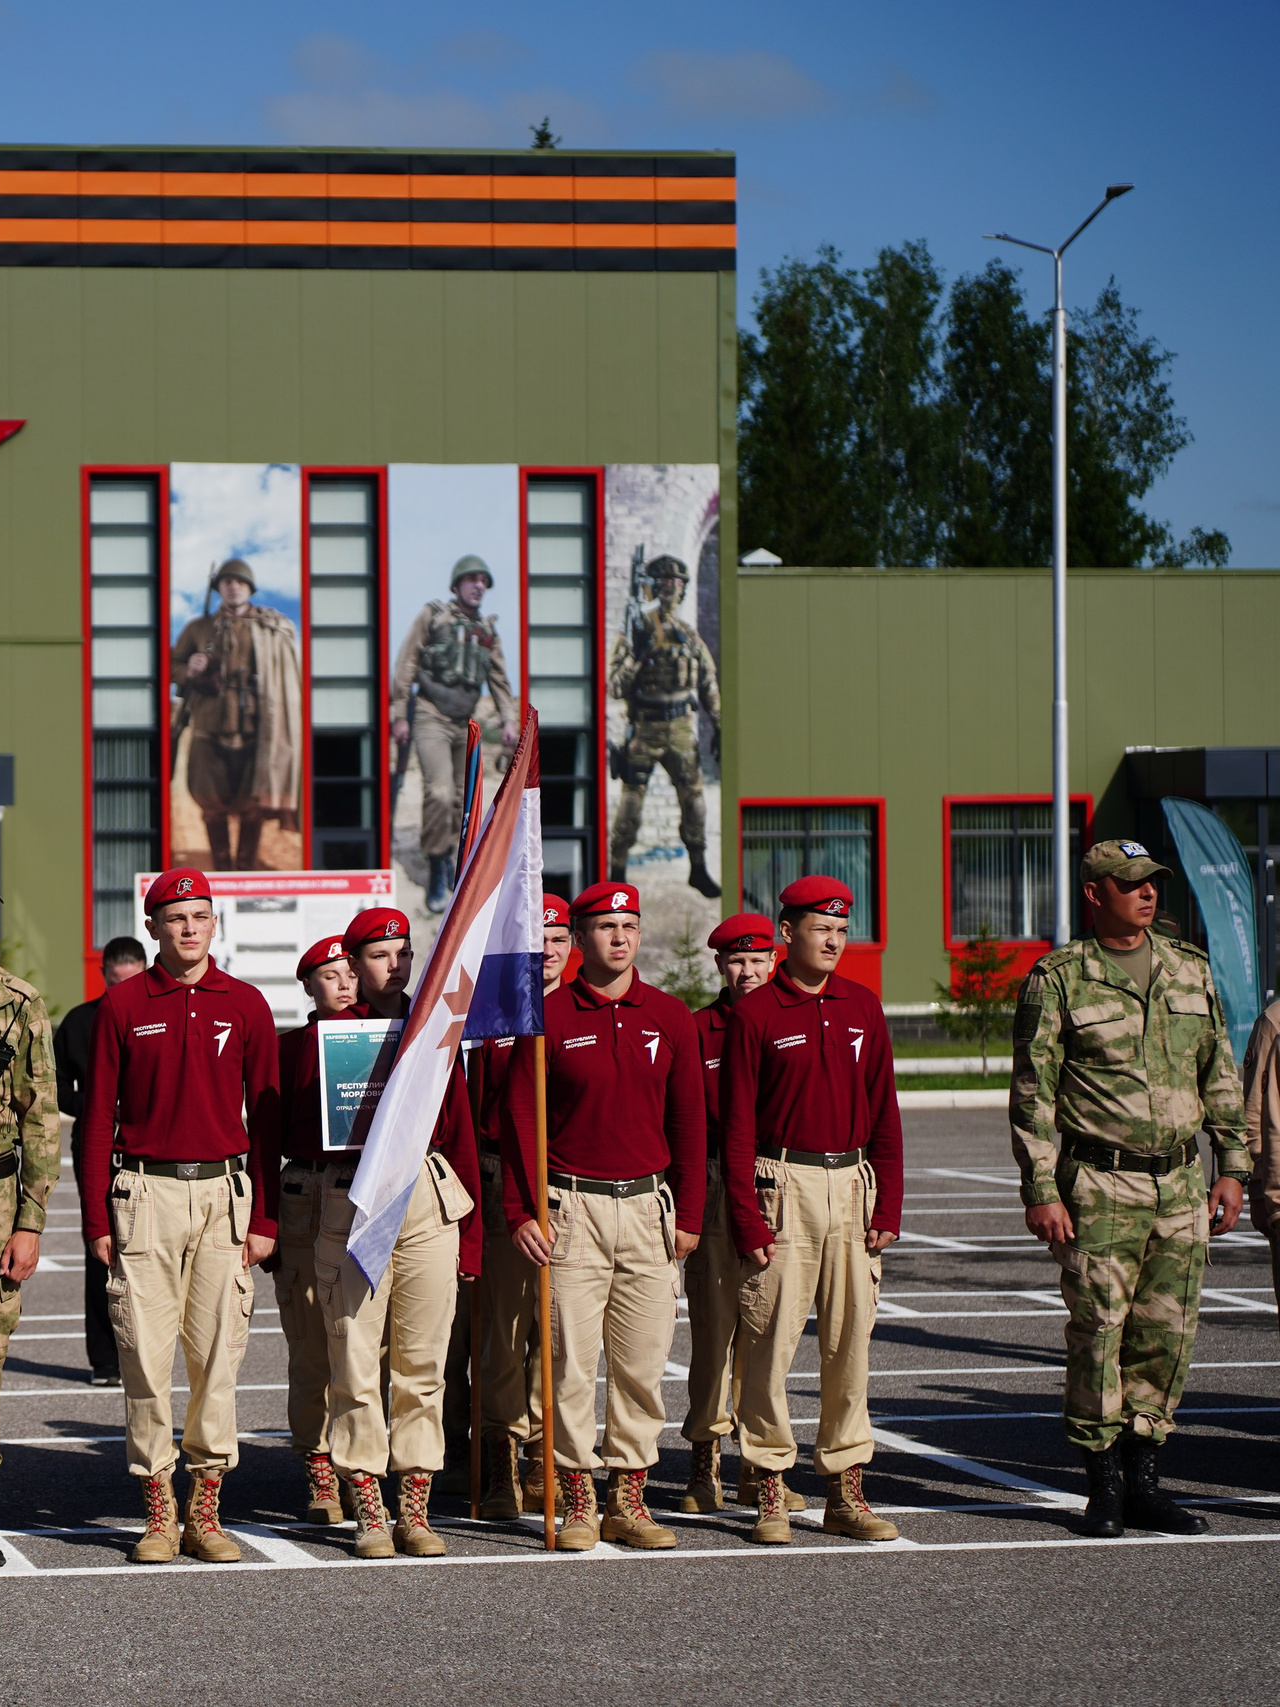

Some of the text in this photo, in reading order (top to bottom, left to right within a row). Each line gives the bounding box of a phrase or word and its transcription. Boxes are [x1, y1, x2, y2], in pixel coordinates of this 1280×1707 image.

[133, 1022, 167, 1032] РЕСПУБЛИКА
[136, 1028, 166, 1037] МОРДОВИЯ
[563, 1034, 597, 1045] РЕСПУБЛИКА
[773, 1033, 807, 1045] РЕСПУБЛИКА
[565, 1039, 597, 1050] МОРДОВИЯ
[777, 1039, 807, 1050] МОРДОВИЯ
[336, 1082, 386, 1090] РЕСПУБЛИК
[340, 1090, 383, 1098] МОРДОВИ
